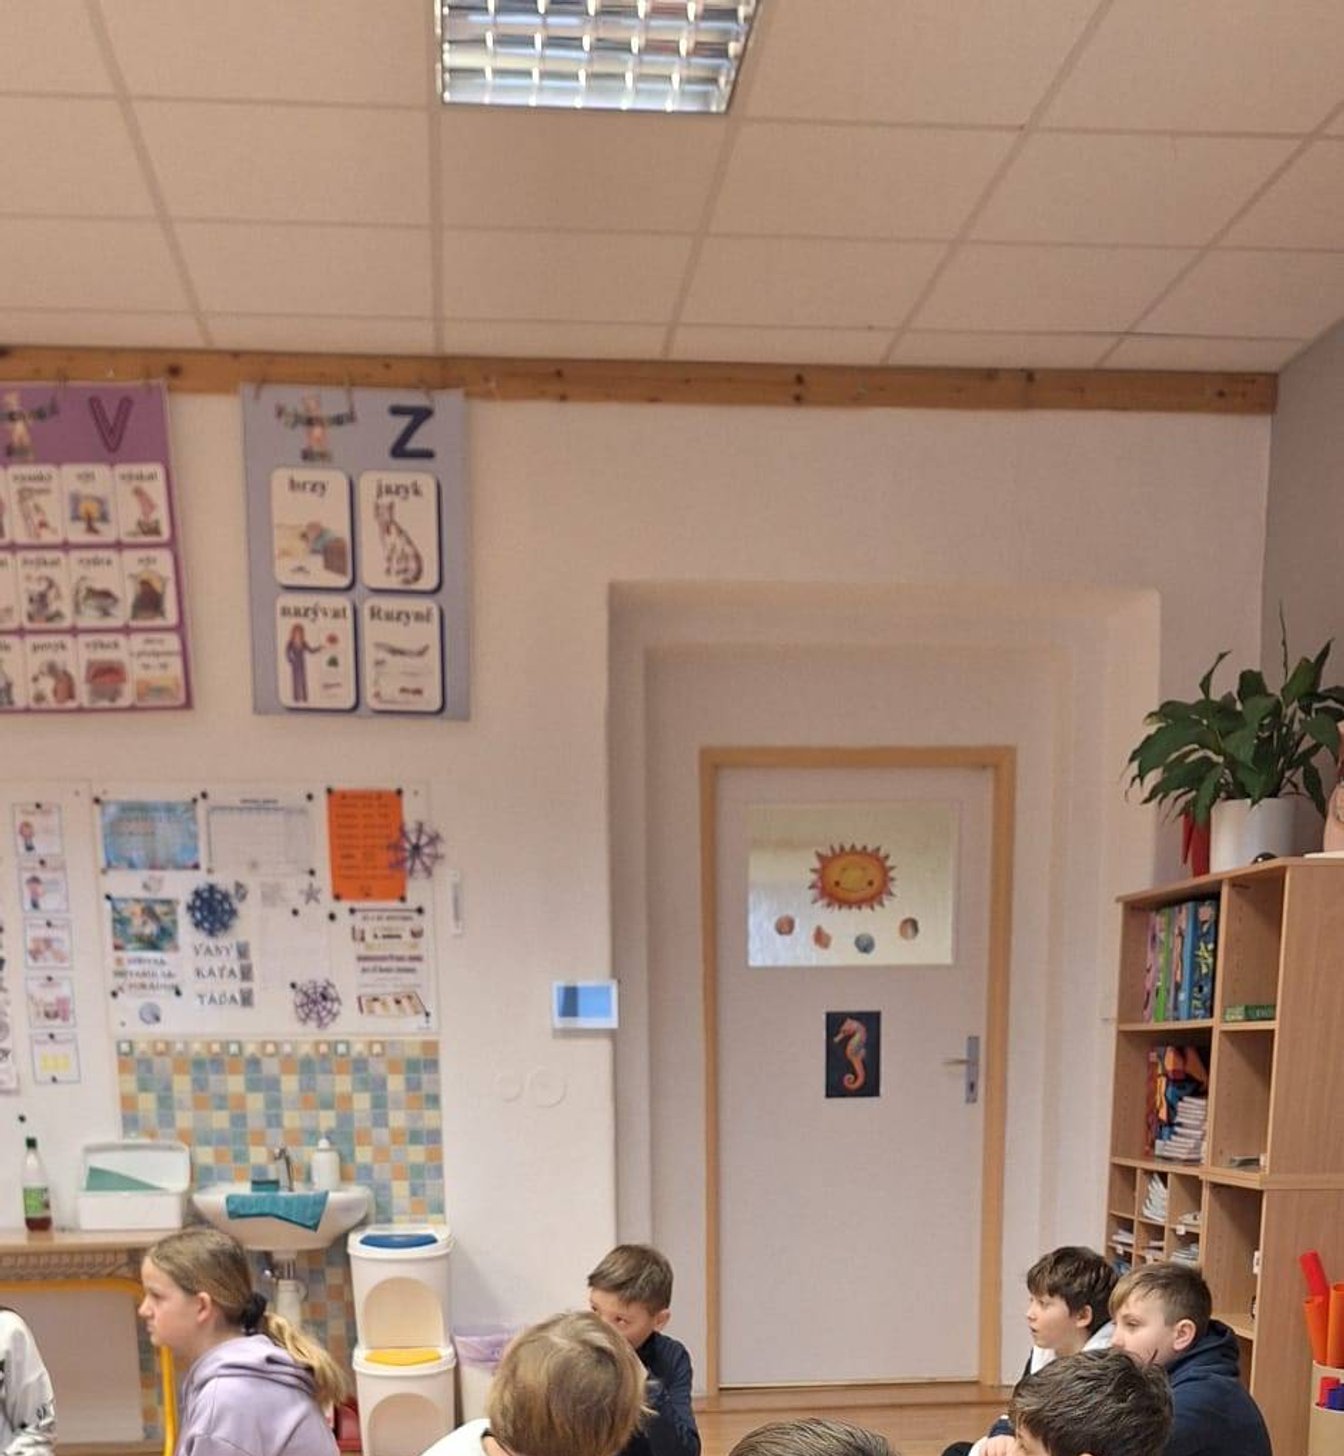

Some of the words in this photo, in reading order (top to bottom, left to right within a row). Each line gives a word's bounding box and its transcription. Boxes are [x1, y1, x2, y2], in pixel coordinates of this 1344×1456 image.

[88, 397, 134, 453] V
[388, 405, 436, 460] Z
[288, 476, 329, 498] brzy
[376, 479, 423, 499] jazyk
[280, 602, 348, 623] nazývat
